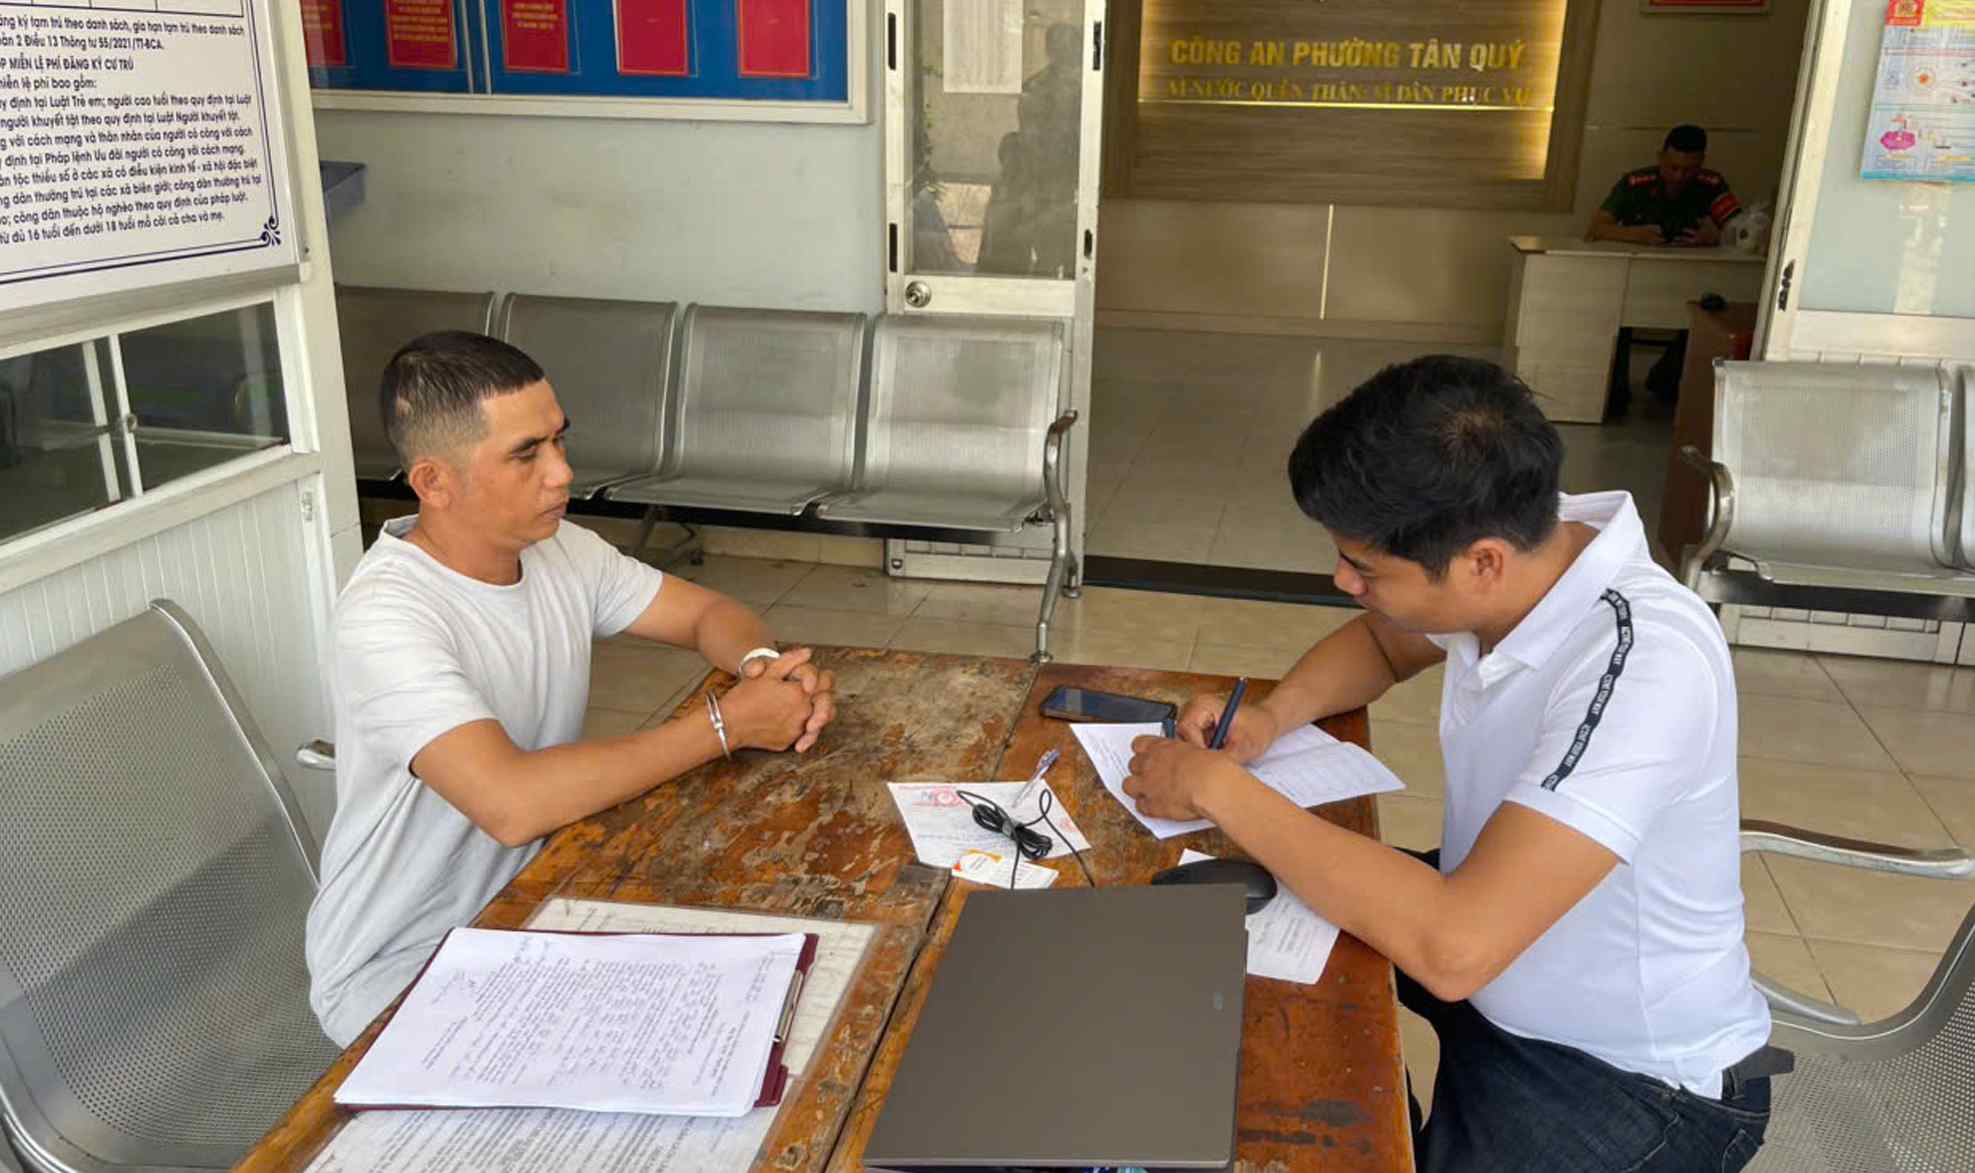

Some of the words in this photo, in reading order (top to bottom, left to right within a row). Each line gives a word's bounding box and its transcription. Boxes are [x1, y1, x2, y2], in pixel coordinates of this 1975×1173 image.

[16, 35, 22, 46] 2
[24, 32, 44, 46] Điều
[48, 36, 58, 46] 13
[60, 36, 86, 51] Thông
[88, 38, 96, 48] tư
[9, 52, 32, 70] MIỄN
[35, 56, 44, 72] LỆ
[46, 56, 60, 70] PHÍ
[63, 56, 88, 70] ĐĂNG
[92, 56, 102, 70] KÝ
[104, 58, 118, 70] CƯ
[120, 56, 134, 70] TRÚ
[1171, 36, 1241, 64] CÔNG
[1251, 40, 1284, 65] AN
[1293, 37, 1399, 67] PHƯỜNG
[1409, 38, 1462, 68] TÂN
[1469, 39, 1526, 72] QUÝ
[22, 76, 30, 90] lệ
[34, 77, 49, 91] phí
[52, 78, 70, 88] bao
[74, 74, 96, 90] gồm:
[10, 97, 31, 110] định
[34, 98, 47, 110] tại
[50, 96, 70, 110] Luật
[72, 94, 86, 108] Trẻ
[88, 98, 106, 108] em;
[108, 94, 132, 109] người
[134, 97, 151, 106] cao
[153, 92, 168, 105] tuổi
[170, 94, 188, 104] theo
[190, 96, 204, 106] quy
[207, 94, 223, 106] định
[225, 94, 235, 106] tại
[237, 94, 251, 107] Luật
